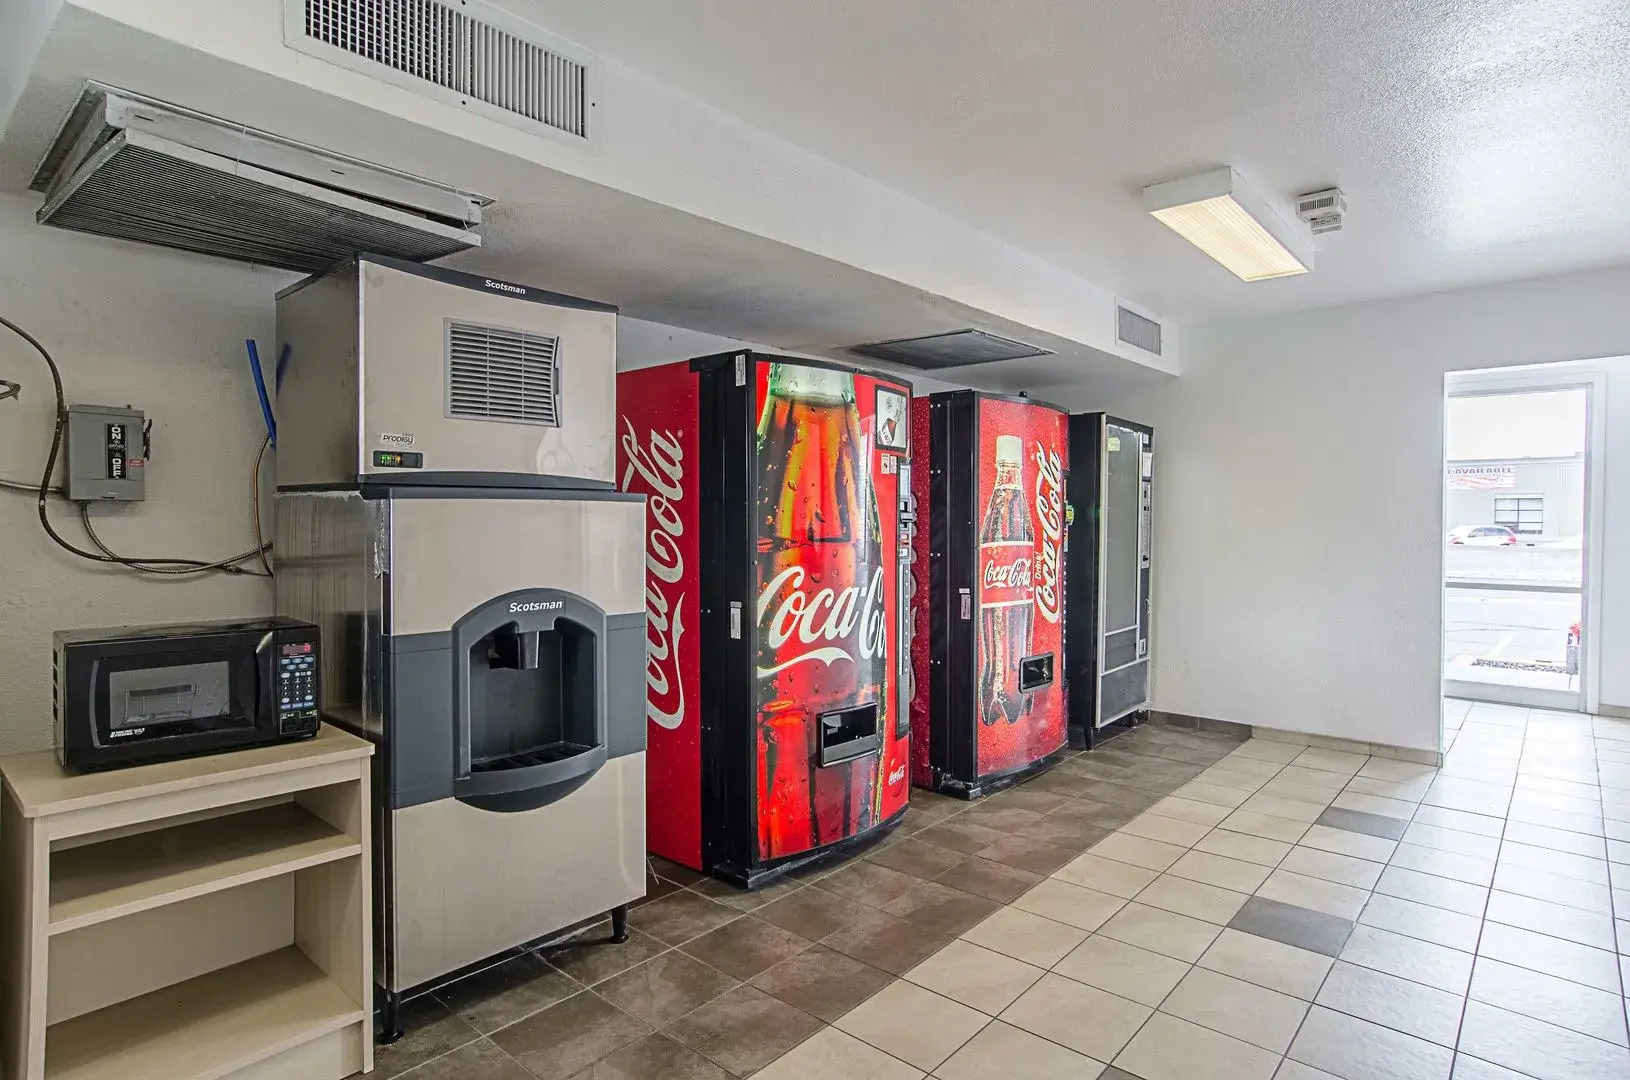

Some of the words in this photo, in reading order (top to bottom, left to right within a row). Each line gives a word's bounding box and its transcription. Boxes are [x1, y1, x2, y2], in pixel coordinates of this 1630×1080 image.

[485, 279, 526, 294] Scotsman
[111, 426, 121, 440] ON
[112, 458, 122, 477] OFF
[984, 557, 1034, 592] Coca-Cola
[509, 601, 563, 613] Scotsman
